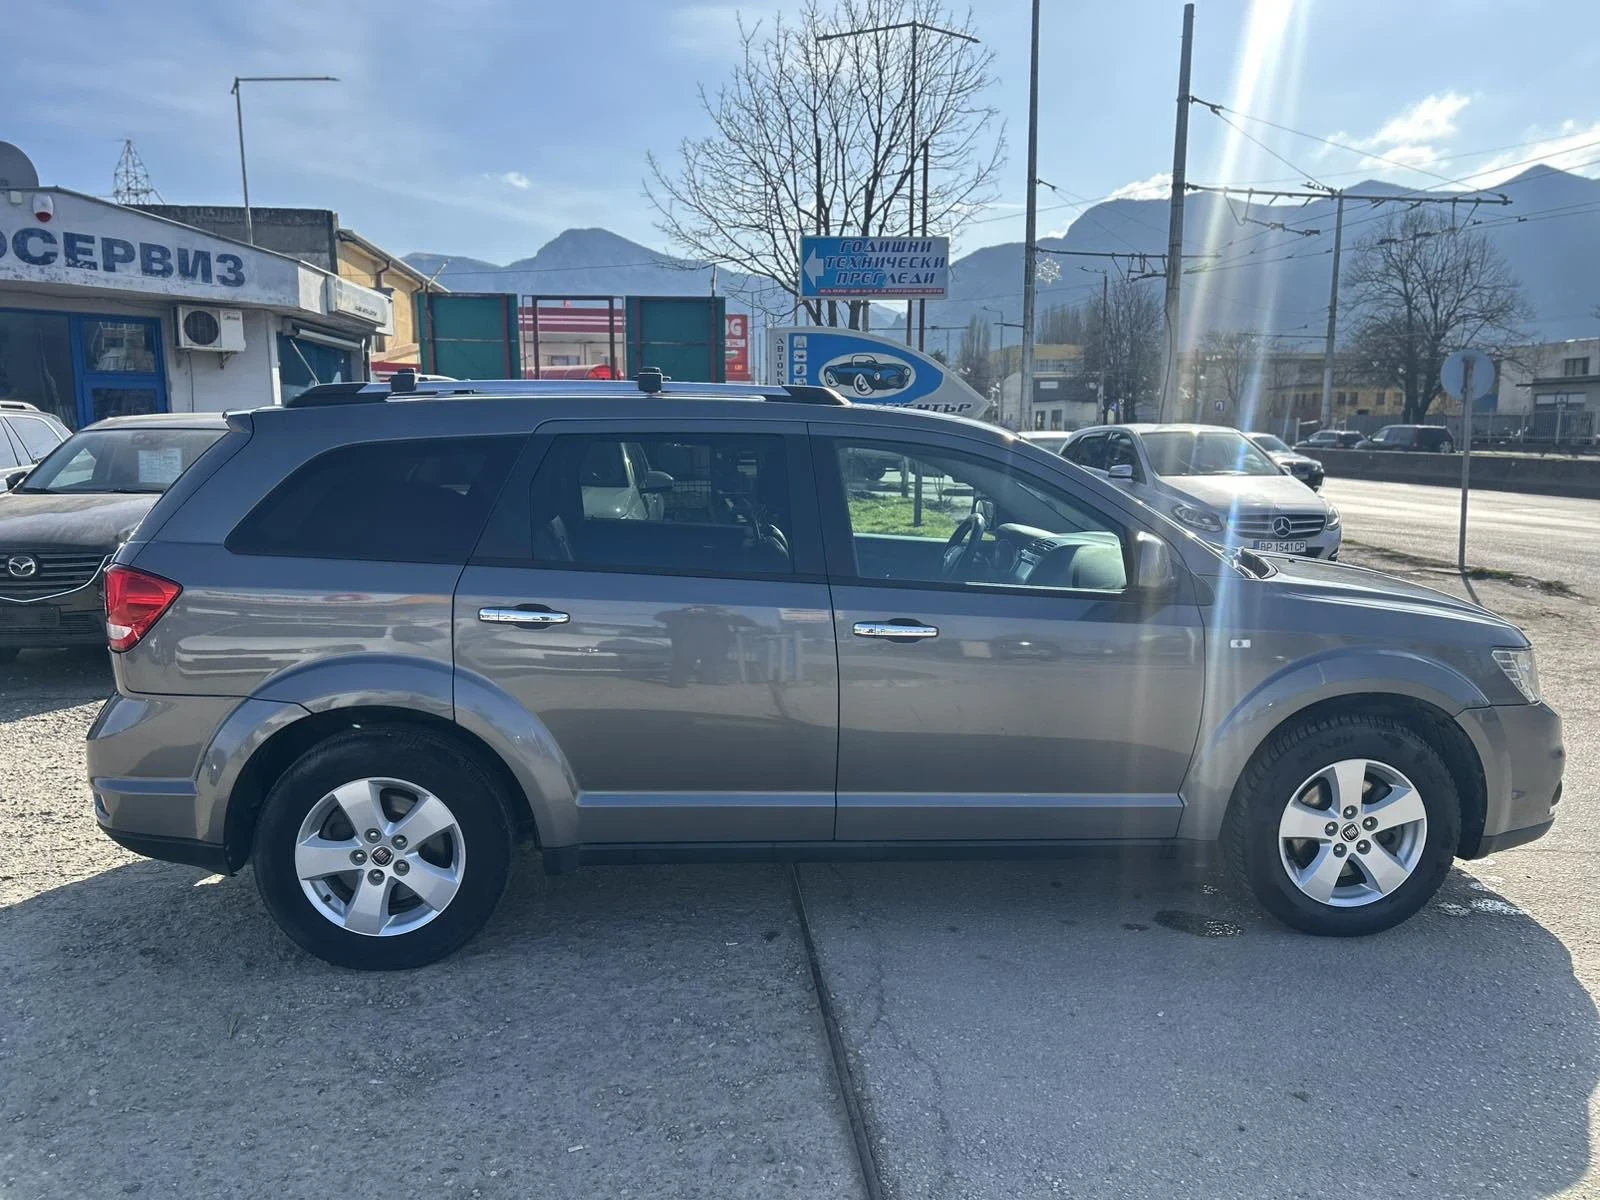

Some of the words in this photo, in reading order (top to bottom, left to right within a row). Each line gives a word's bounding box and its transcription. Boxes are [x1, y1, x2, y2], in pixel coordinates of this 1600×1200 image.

[840, 240, 932, 253] ГОДИШНИ
[0, 227, 246, 287] СЕРВИЗ
[825, 256, 945, 269] ТЕХНИЧЕСКИ
[836, 271, 935, 284] ПРЕГЛЕДИ
